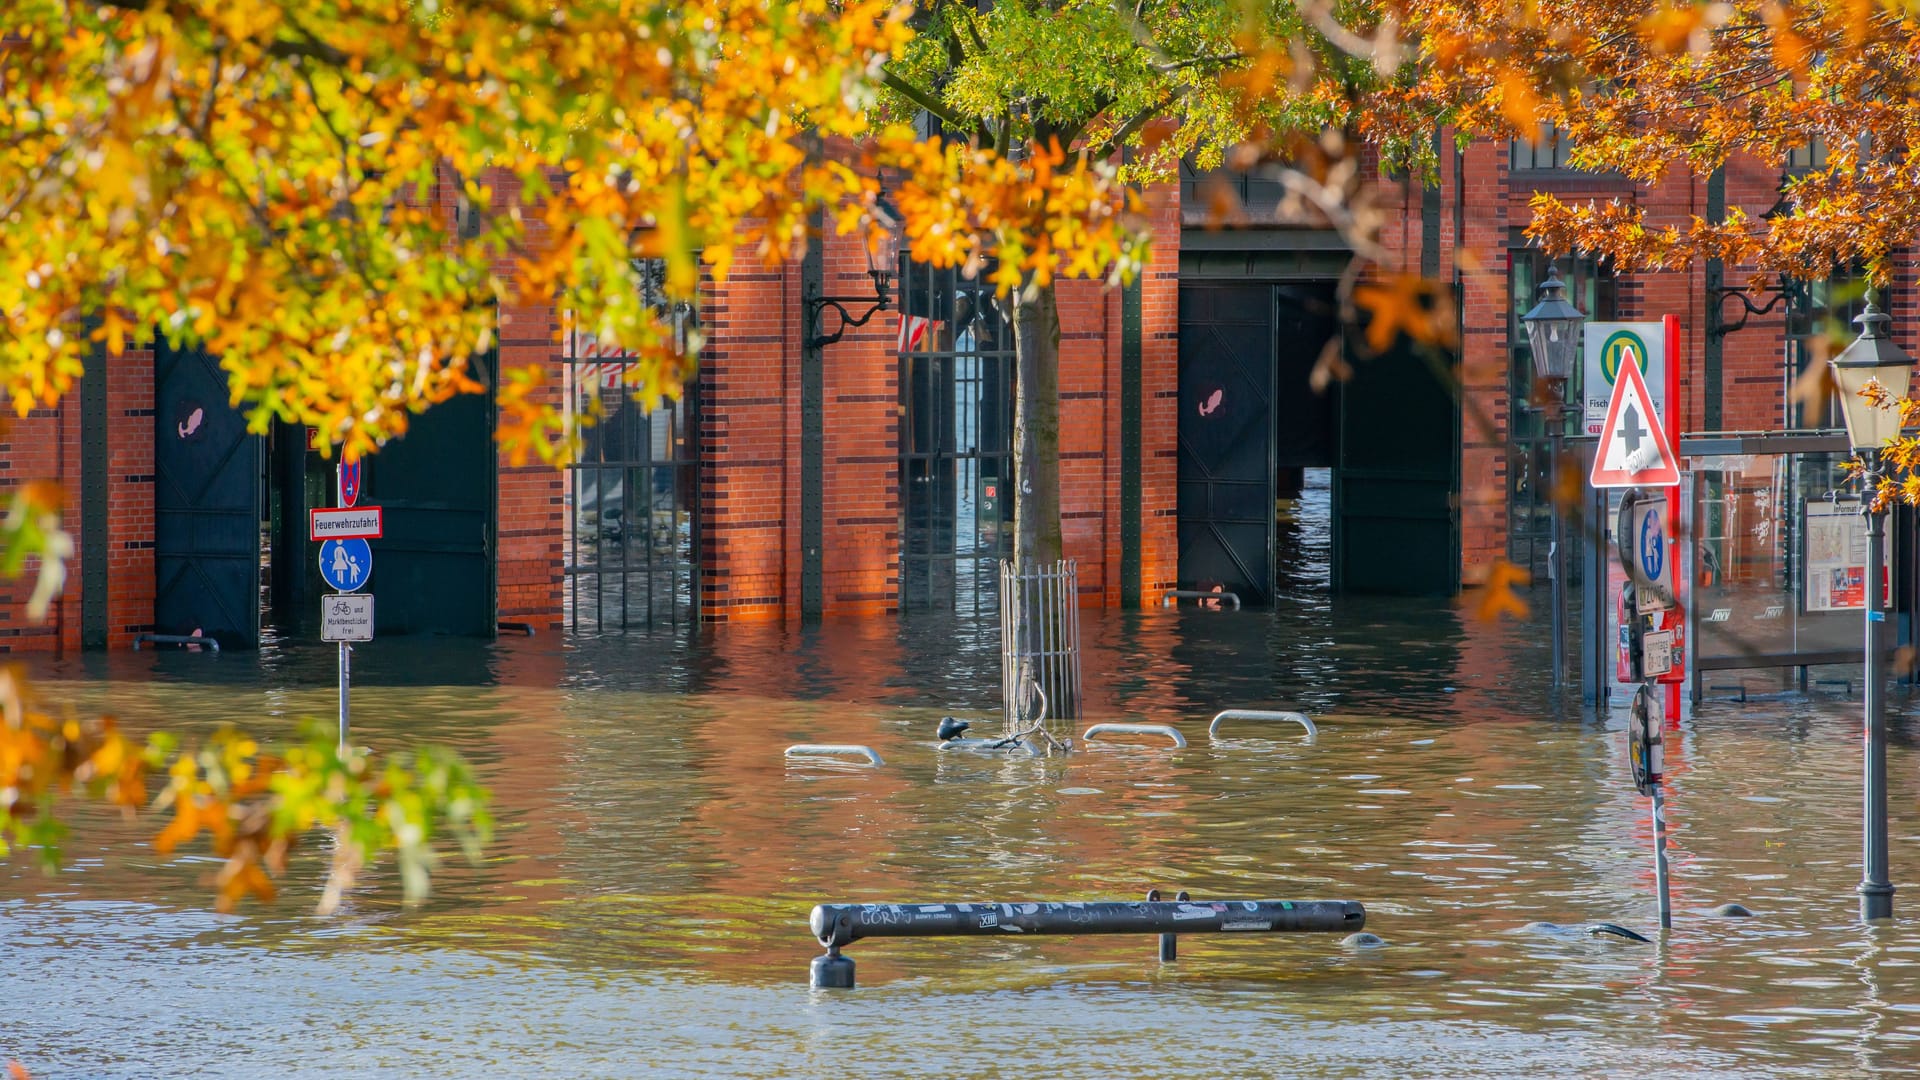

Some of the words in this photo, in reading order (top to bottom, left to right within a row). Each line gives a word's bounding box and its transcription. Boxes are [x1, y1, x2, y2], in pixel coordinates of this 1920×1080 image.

[315, 517, 378, 530] Feuerwehrzufahrt
[1646, 585, 1665, 604] ZONE
[354, 605, 364, 613] und
[1713, 610, 1731, 621] HVV
[342, 626, 354, 635] frei
